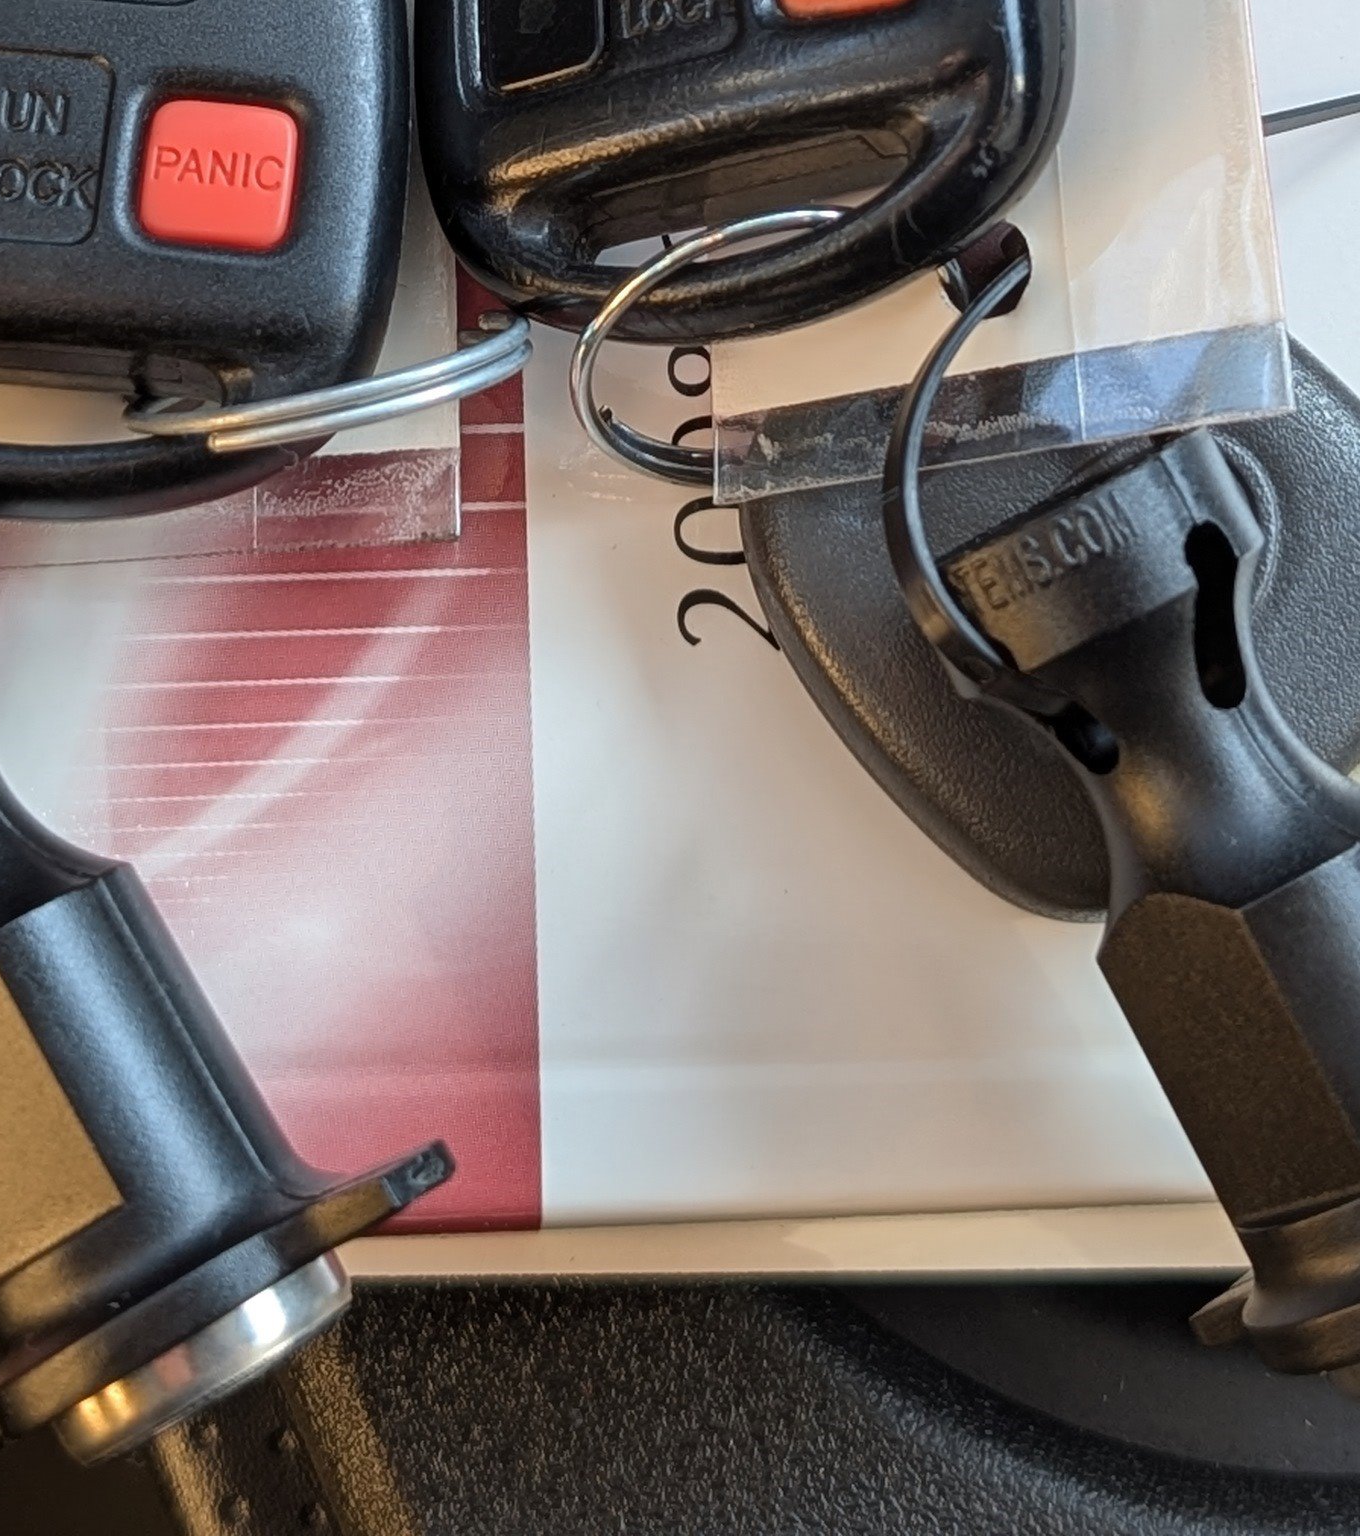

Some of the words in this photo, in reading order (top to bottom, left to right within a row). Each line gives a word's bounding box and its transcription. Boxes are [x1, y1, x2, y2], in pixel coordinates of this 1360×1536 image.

[0, 87, 71, 136] UN
[153, 145, 285, 192] PANIC
[667, 344, 781, 652] 20
